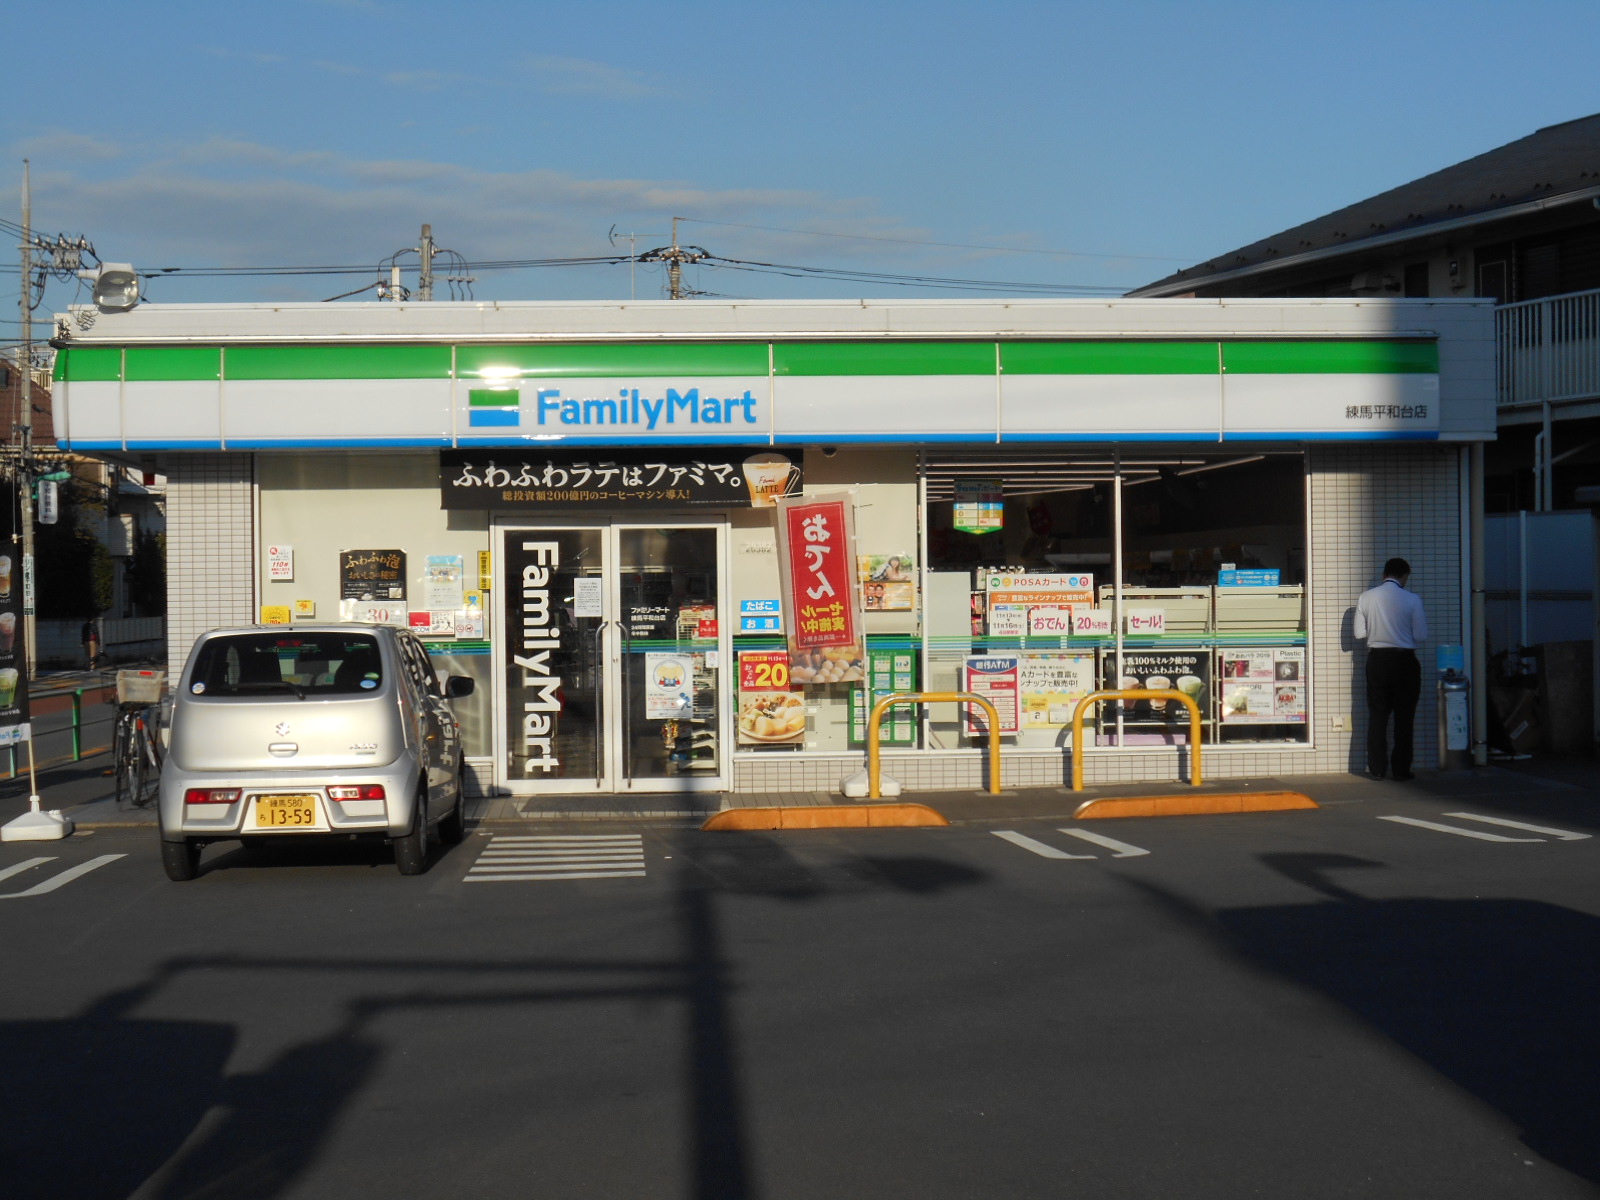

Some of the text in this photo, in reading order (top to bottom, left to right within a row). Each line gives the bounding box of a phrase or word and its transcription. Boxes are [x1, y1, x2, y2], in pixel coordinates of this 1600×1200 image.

[537, 388, 757, 430] FamilyMart
[1345, 405, 1428, 419] 練馬平和台店
[452, 460, 741, 488] ふわふわラテはファミマ。
[755, 485, 779, 494] LATTE
[1014, 577, 1067, 586] POSAカード
[630, 606, 671, 614] ファミリーマート
[746, 601, 774, 611] たばこ
[367, 608, 389, 622] 30
[1130, 614, 1163, 629] セール!
[1033, 616, 1066, 630] おでん
[1077, 617, 1109, 630] 20%引き
[513, 541, 561, 772] FamilyMart
[975, 660, 1010, 670] 銀行ATM
[755, 663, 788, 687] 20
[288, 799, 303, 807] 580
[270, 809, 312, 825] 13-59
